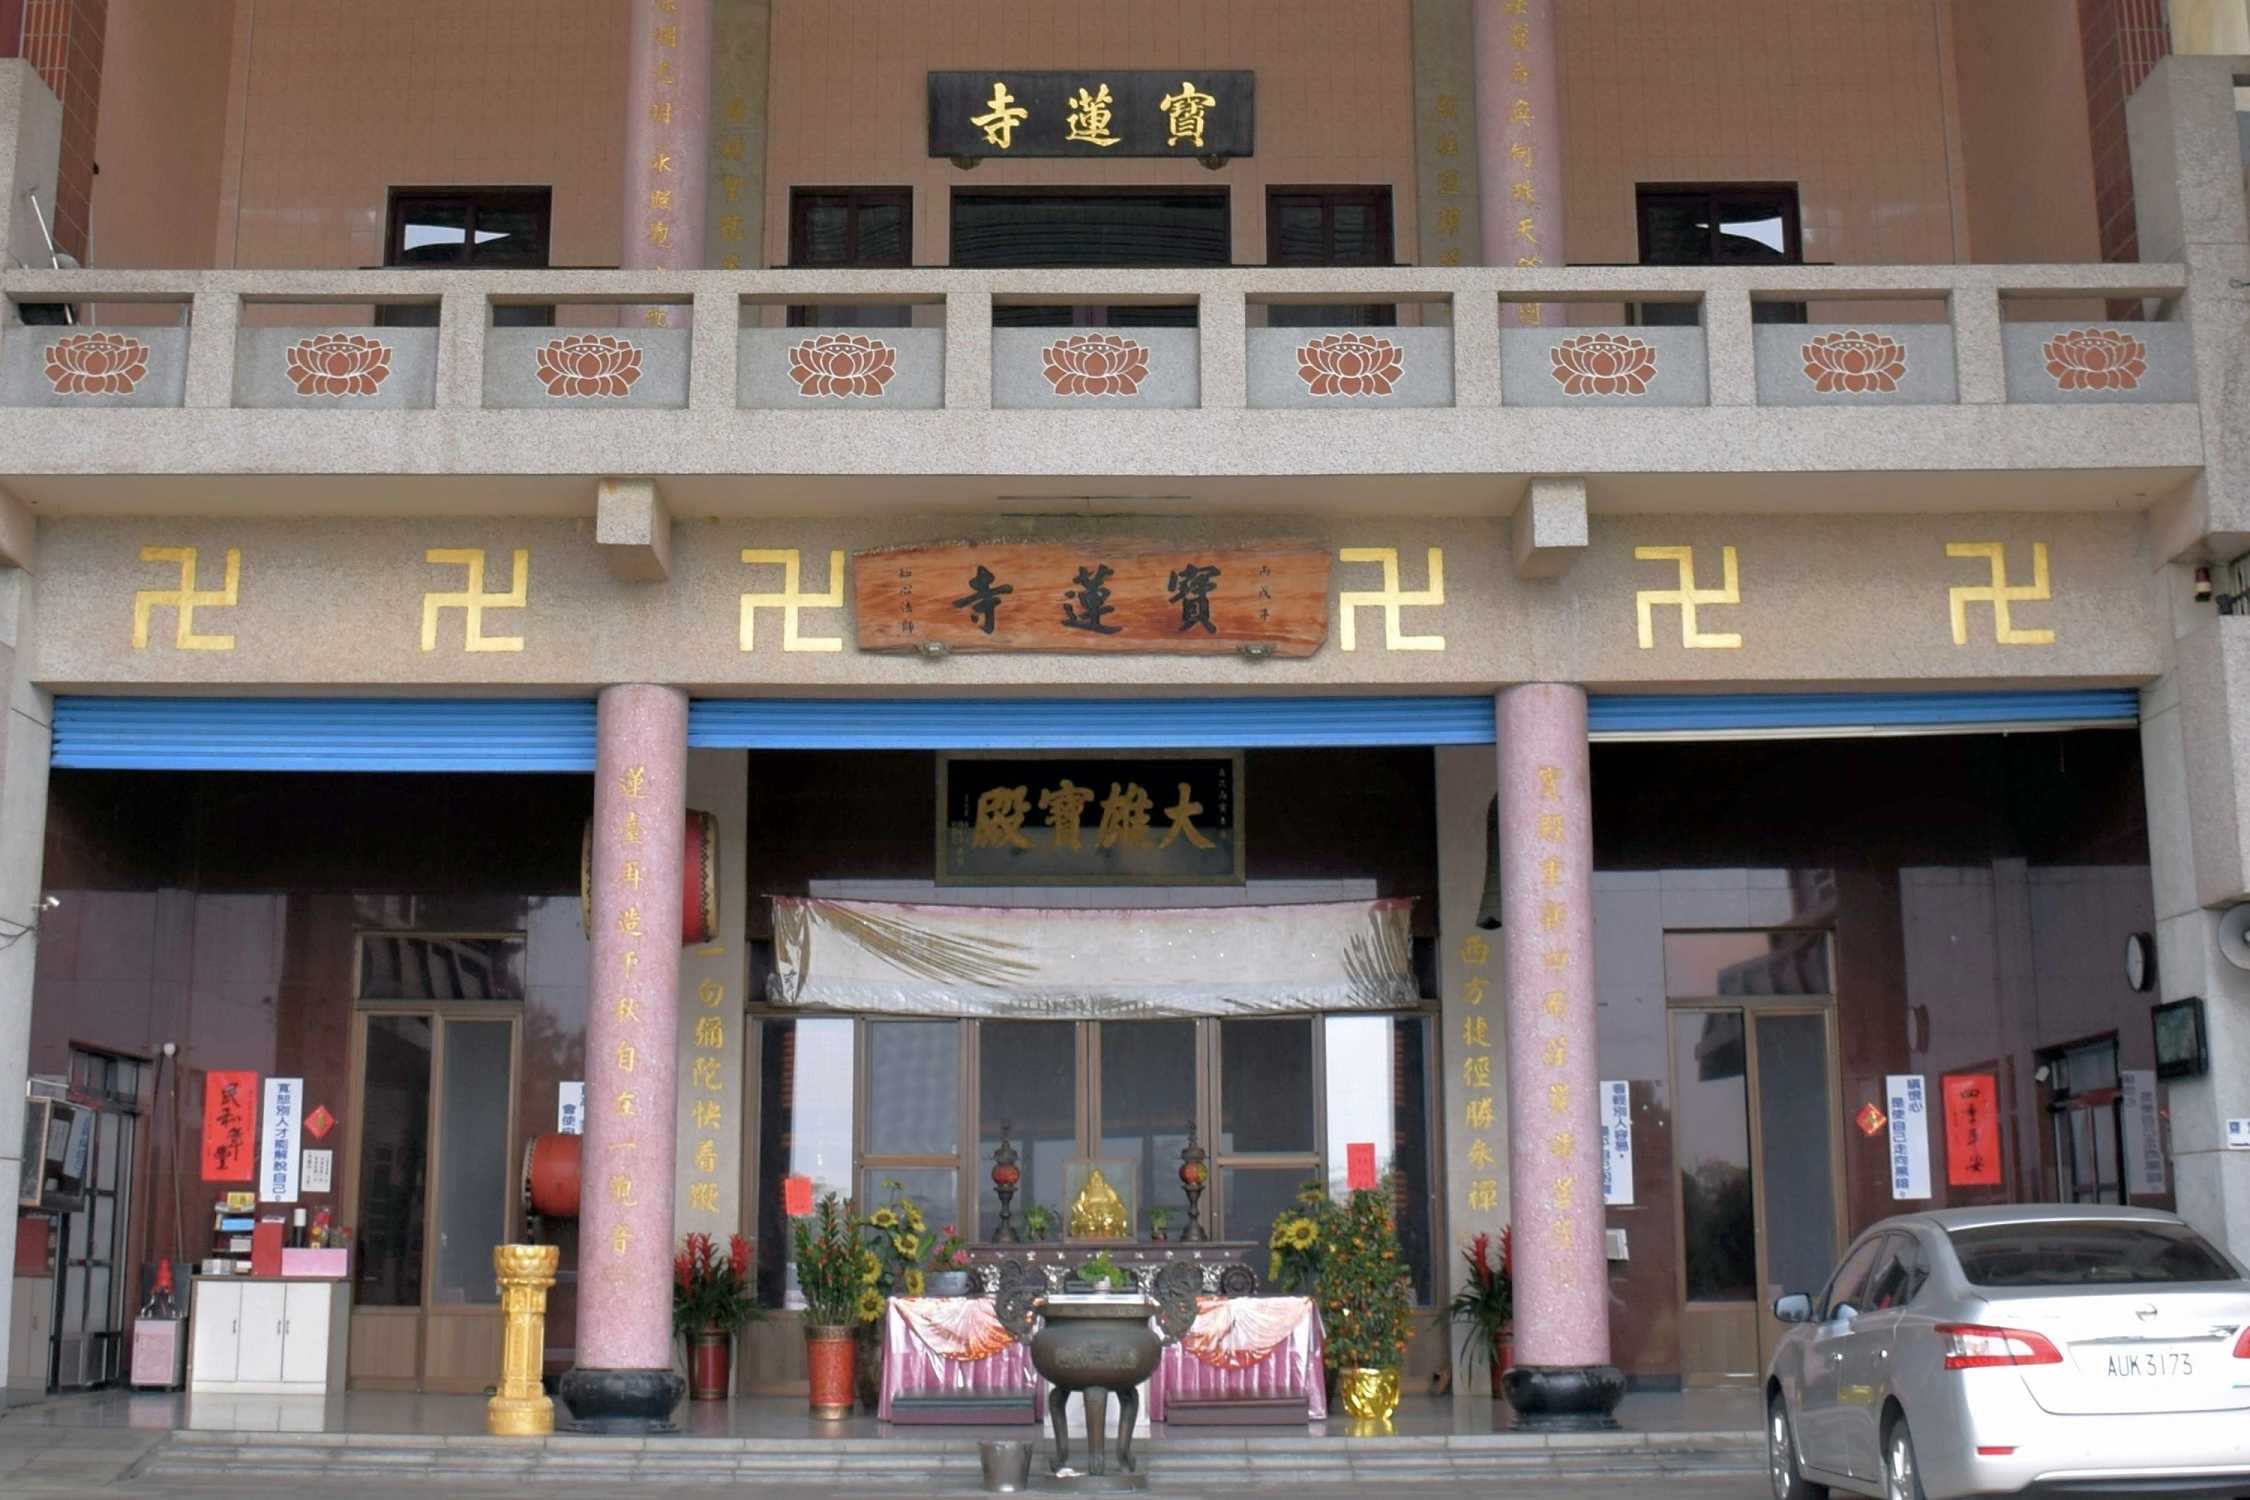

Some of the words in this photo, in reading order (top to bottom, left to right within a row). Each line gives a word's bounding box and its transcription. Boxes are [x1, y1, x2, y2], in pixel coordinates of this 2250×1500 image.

[969, 81, 1217, 149] 寶蓮寺
[952, 563, 1222, 636] 寶蓮寺
[971, 779, 1217, 852] 大雄寶殿
[2107, 1354, 2142, 1376] AUK
